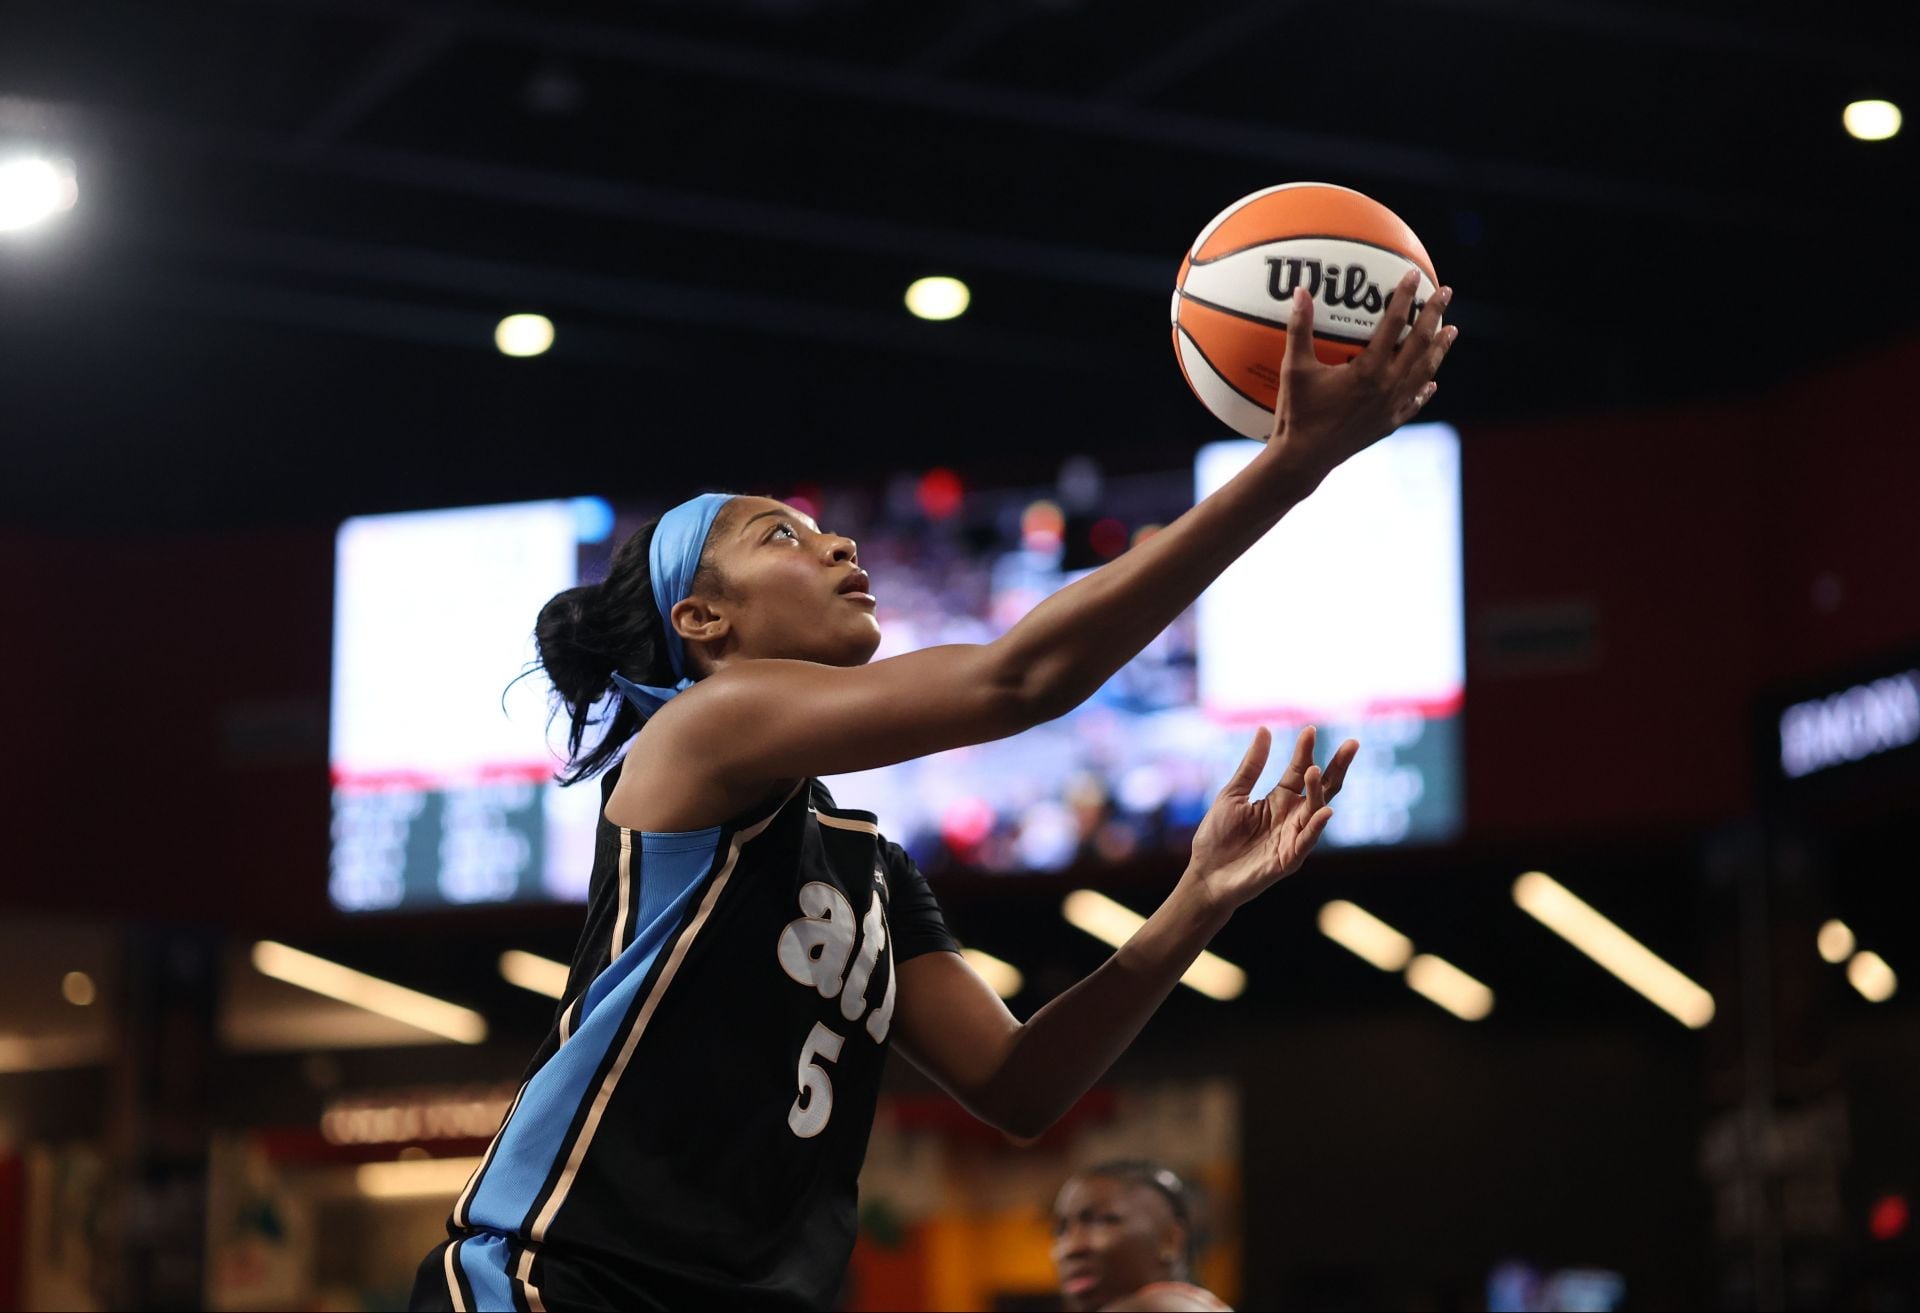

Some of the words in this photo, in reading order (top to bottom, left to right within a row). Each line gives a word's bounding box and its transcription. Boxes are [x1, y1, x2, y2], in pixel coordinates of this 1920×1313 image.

[1329, 314, 1352, 325] EVO
[1353, 318, 1376, 329] NXT
[787, 1019, 846, 1139] 5
